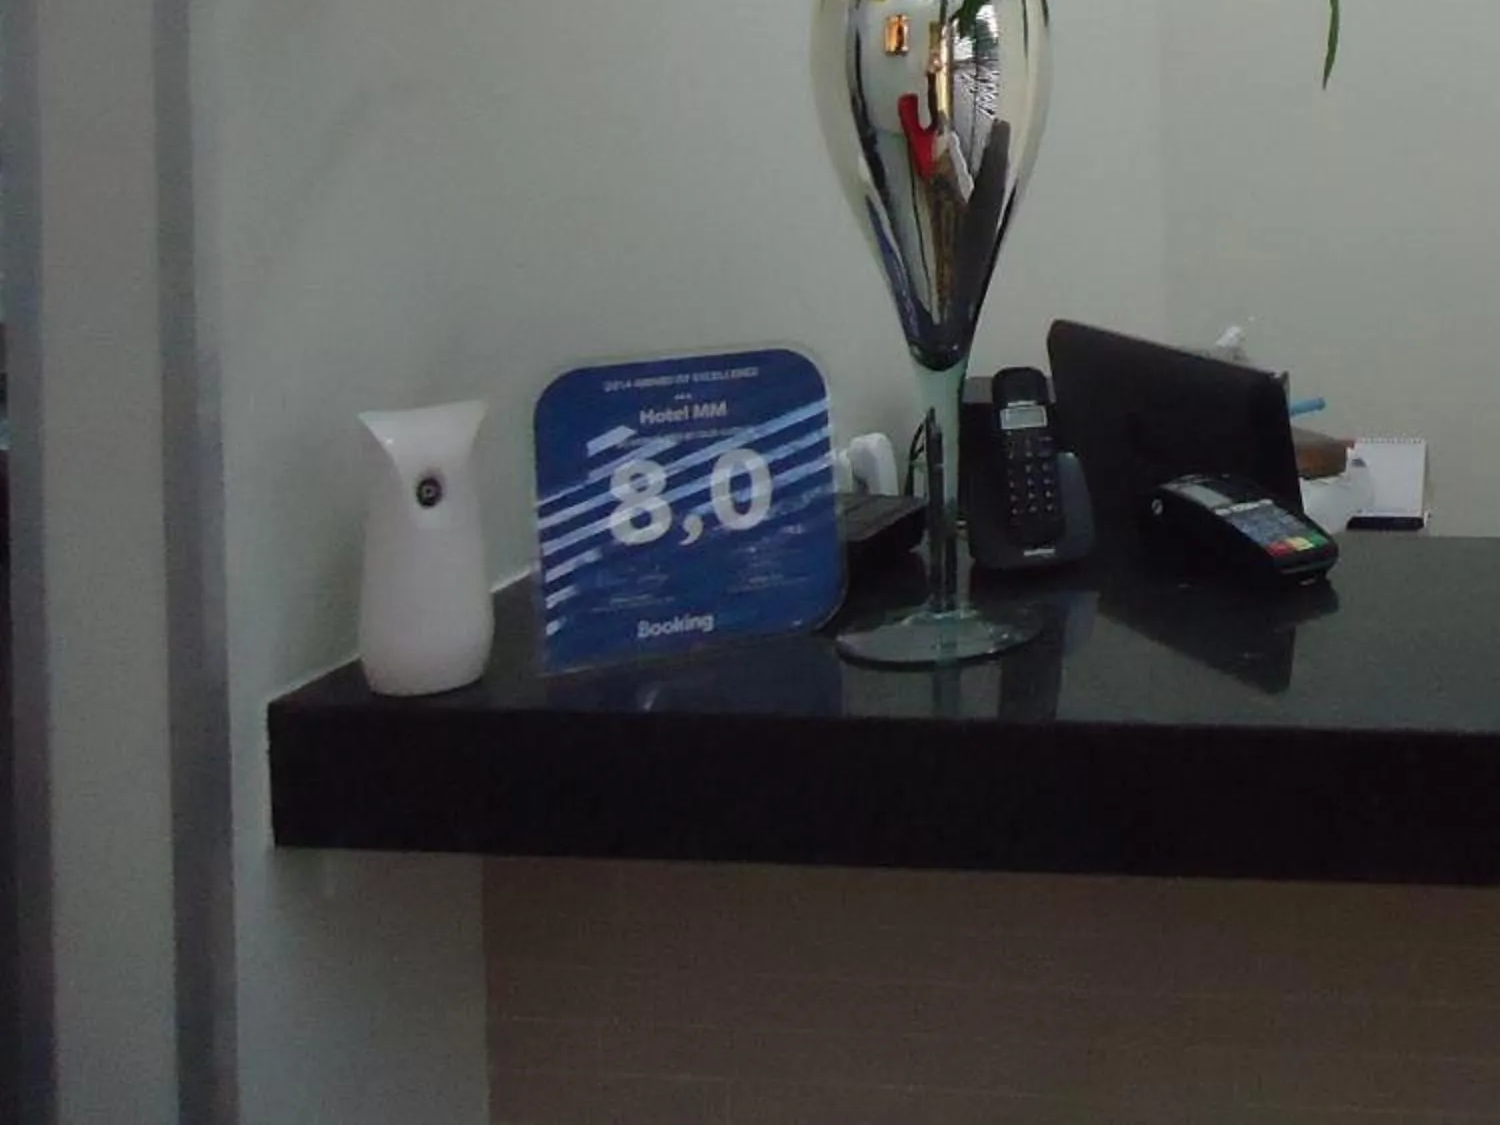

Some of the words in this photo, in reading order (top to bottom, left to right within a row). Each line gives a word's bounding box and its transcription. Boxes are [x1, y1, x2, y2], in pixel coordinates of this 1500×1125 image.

[639, 405, 689, 425] Hotel
[692, 401, 727, 419] MM
[609, 448, 773, 545] 8,0
[636, 614, 714, 638] Booking
